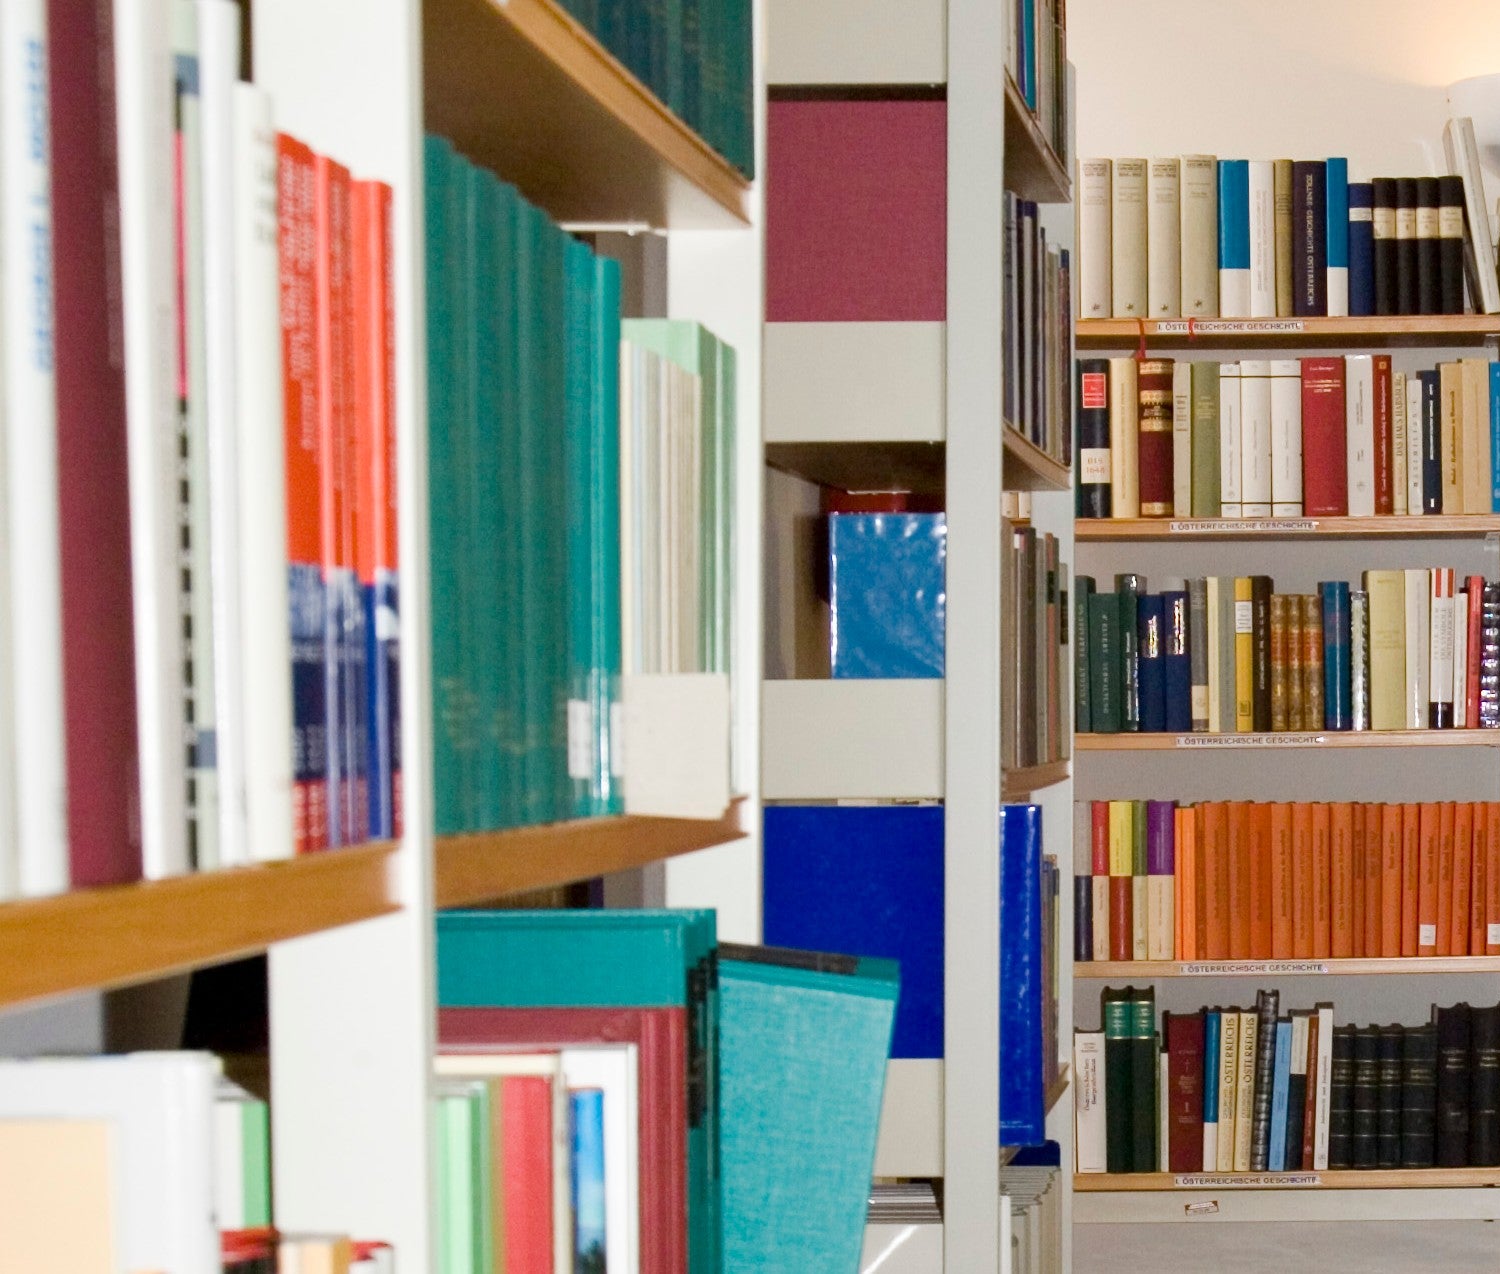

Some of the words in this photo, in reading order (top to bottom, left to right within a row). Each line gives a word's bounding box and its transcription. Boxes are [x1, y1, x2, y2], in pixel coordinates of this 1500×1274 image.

[1306, 209, 1314, 254] GESCHICHTE
[1165, 323, 1243, 331] ÖSTEREICHISCHE
[1394, 419, 1402, 439] HAUS
[1178, 522, 1258, 531] ÖSTERREICHISCHE
[1260, 521, 1314, 530] GESCHICHTE
[1184, 737, 1263, 745] ÖSTERREICHISCHE
[1188, 964, 1266, 973] ÖSTERREICHISCHE
[1269, 964, 1323, 972] GESCHICHTE
[1223, 1017, 1235, 1084] ÖSTERREICHS
[1242, 1017, 1255, 1083] ÖSTERREICHS
[1182, 1176, 1260, 1185] ÖSTERREICHISCHE
[1263, 1176, 1317, 1184] GESCHICHTE
